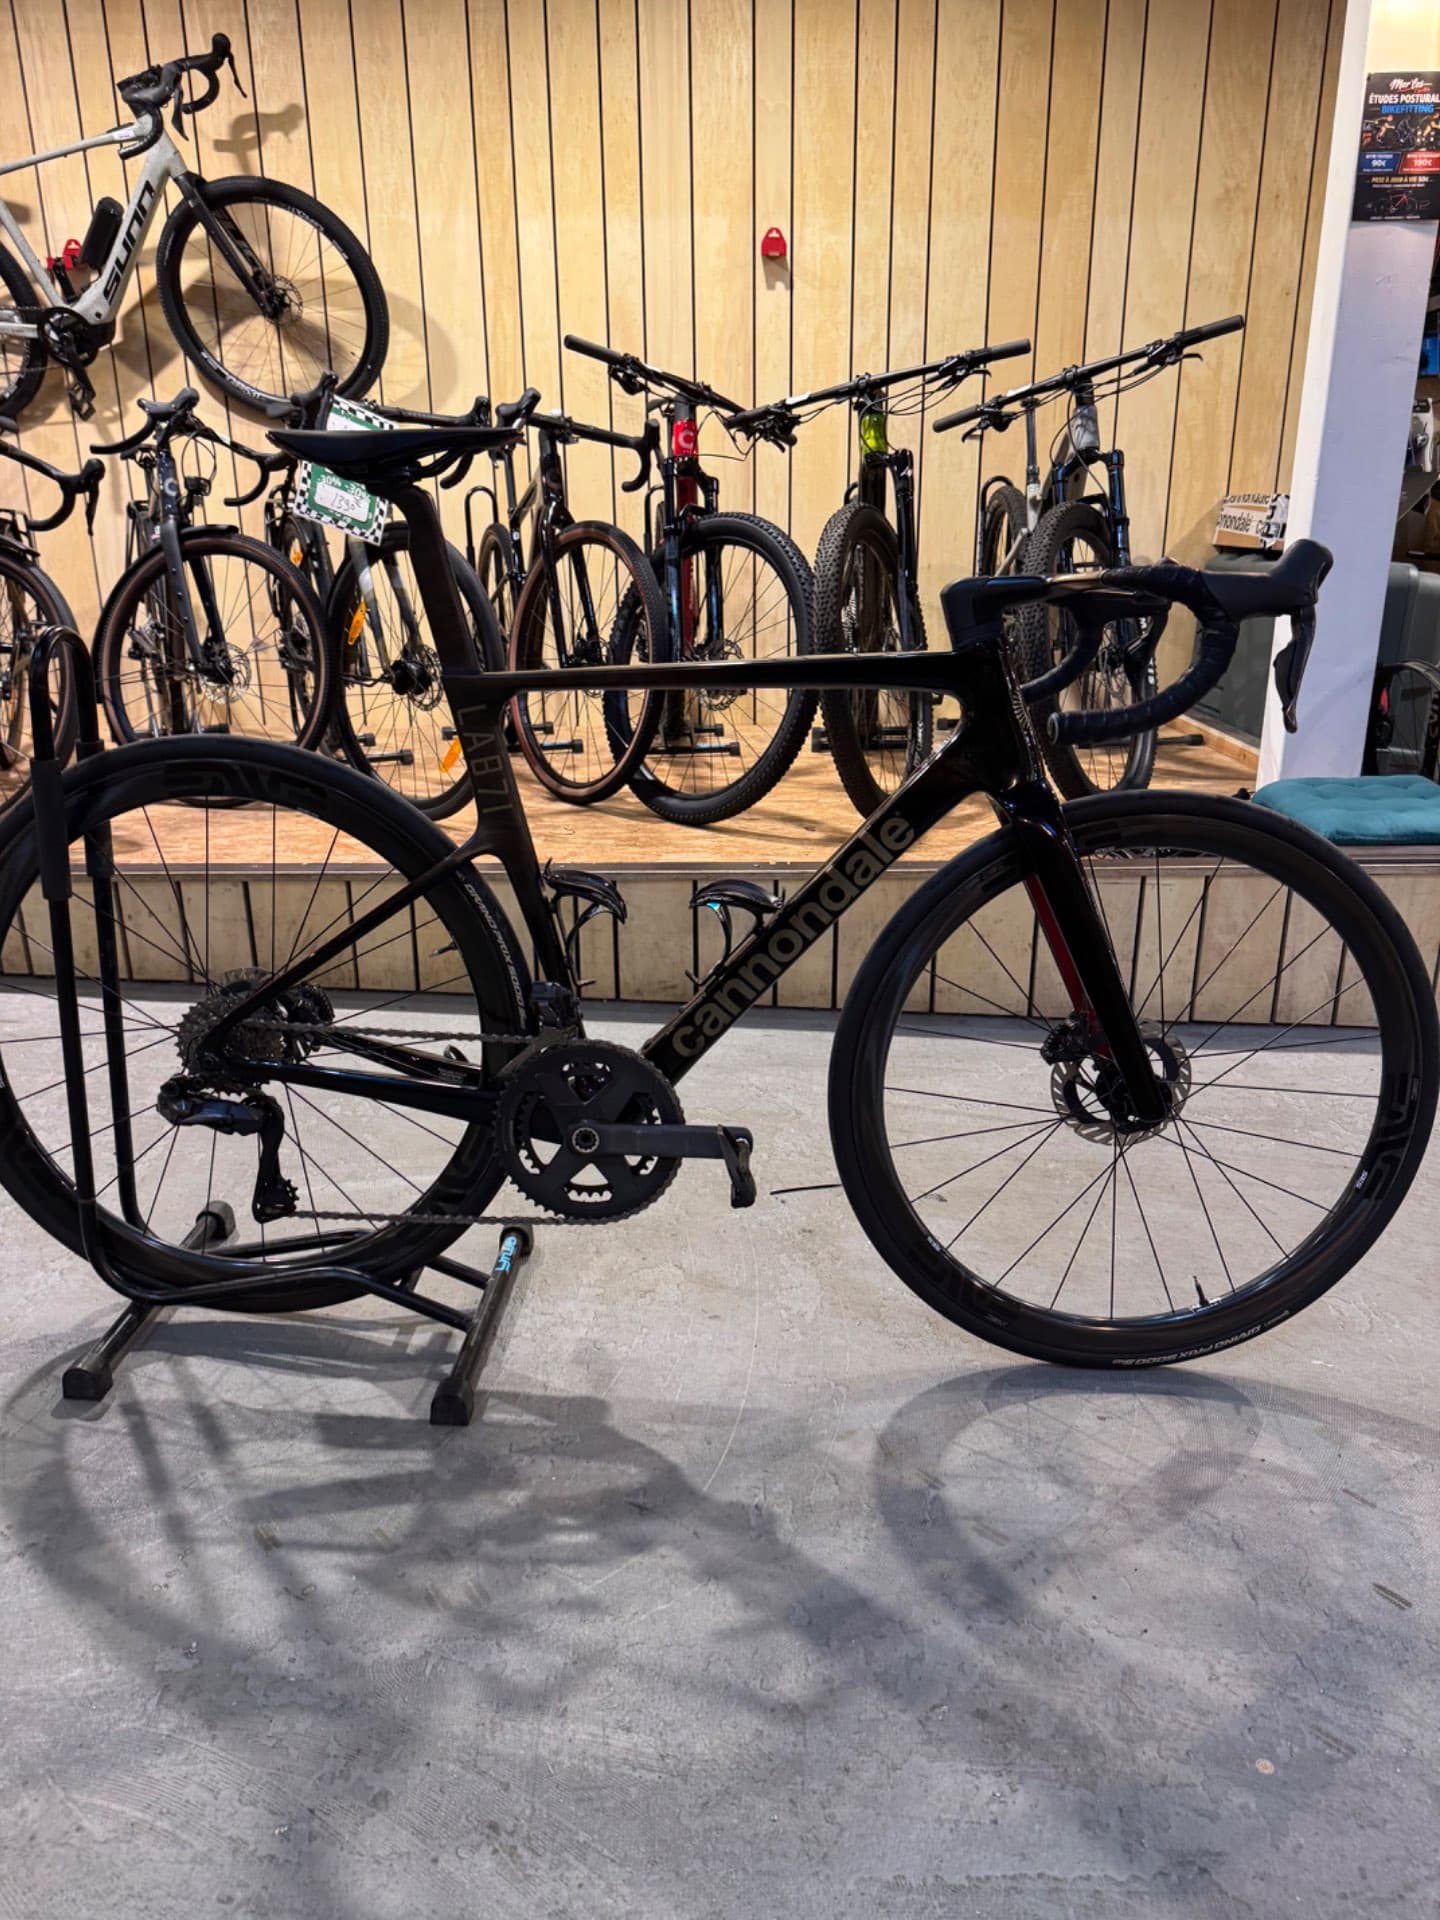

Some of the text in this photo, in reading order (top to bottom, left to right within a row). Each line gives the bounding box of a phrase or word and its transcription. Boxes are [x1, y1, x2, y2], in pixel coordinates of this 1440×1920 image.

[1368, 93, 1399, 104] ÉTUDES
[457, 704, 513, 814] LAB71
[463, 883, 499, 934] GRAND
[495, 929, 513, 964] PRIX
[507, 963, 525, 1007] 5000
[671, 815, 916, 1057] cannondale
[1177, 1343, 1214, 1359] PRIX
[1214, 1324, 1262, 1349] GRAND
